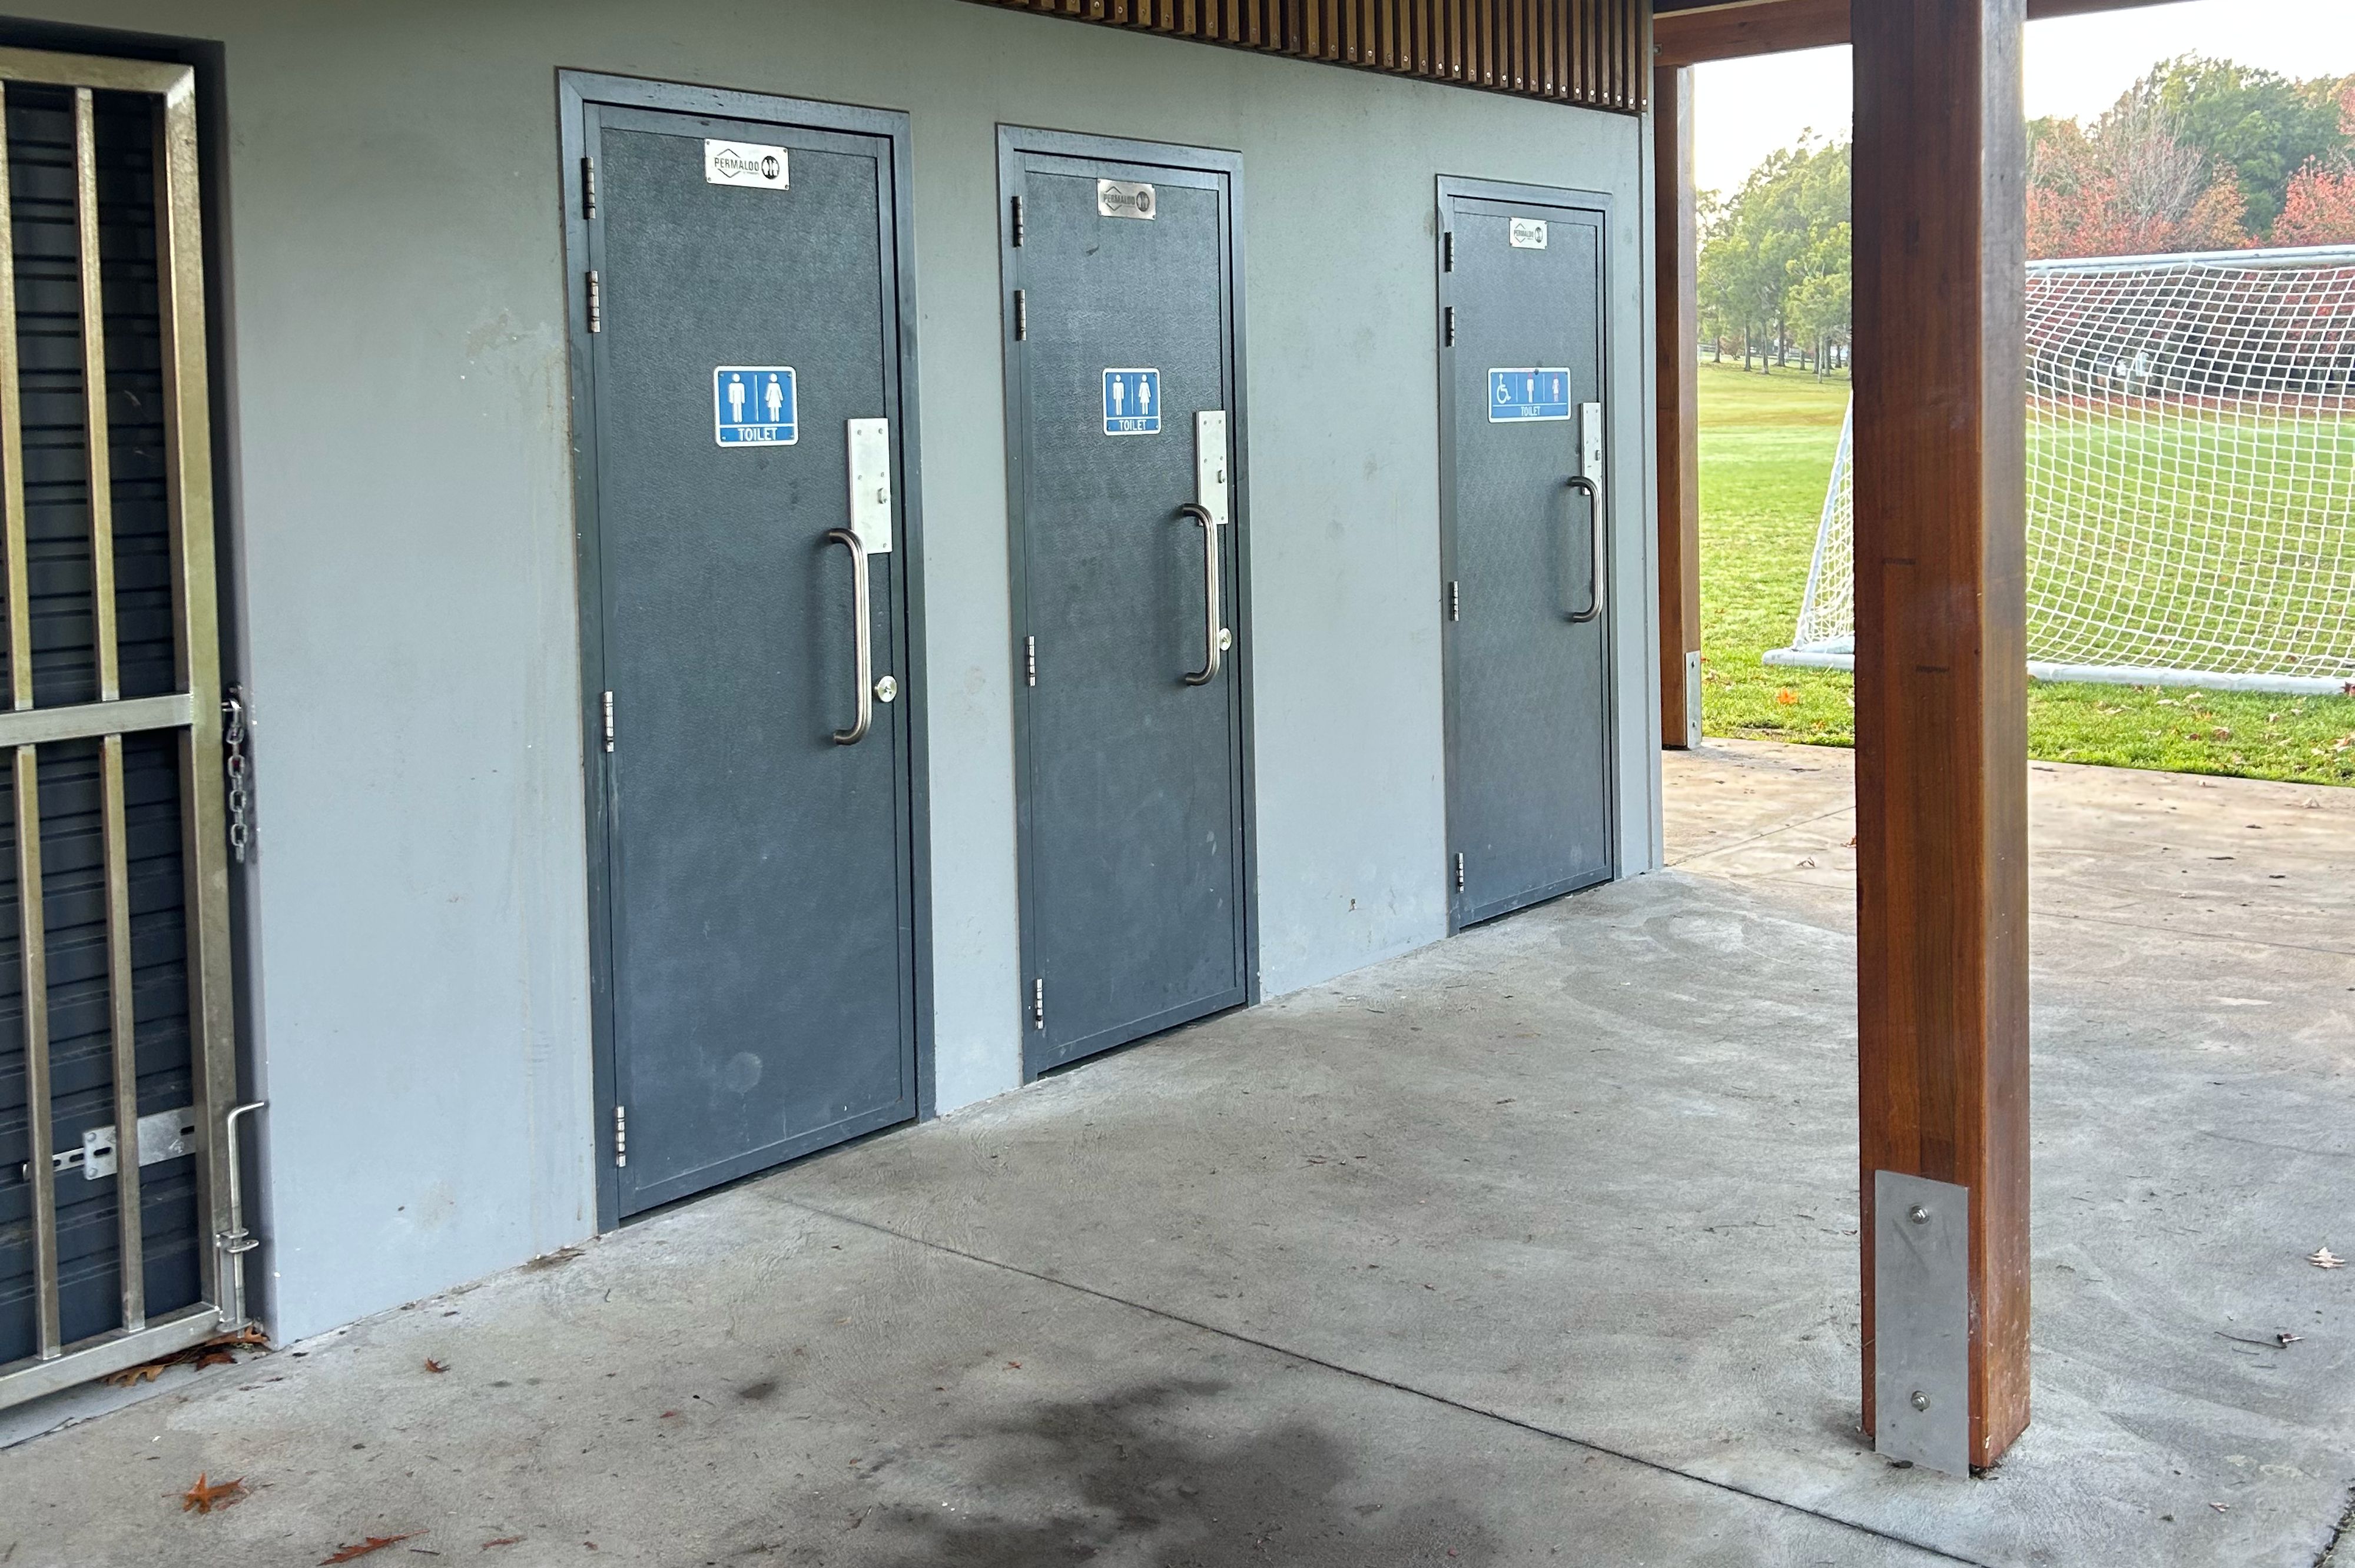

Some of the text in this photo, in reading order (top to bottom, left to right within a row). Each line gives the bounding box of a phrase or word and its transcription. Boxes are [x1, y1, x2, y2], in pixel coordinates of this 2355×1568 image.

[714, 157, 759, 171] PERMALOO
[1521, 406, 1541, 416] TOILET
[1119, 419, 1147, 431] TOILET
[738, 428, 778, 441] TOILET
